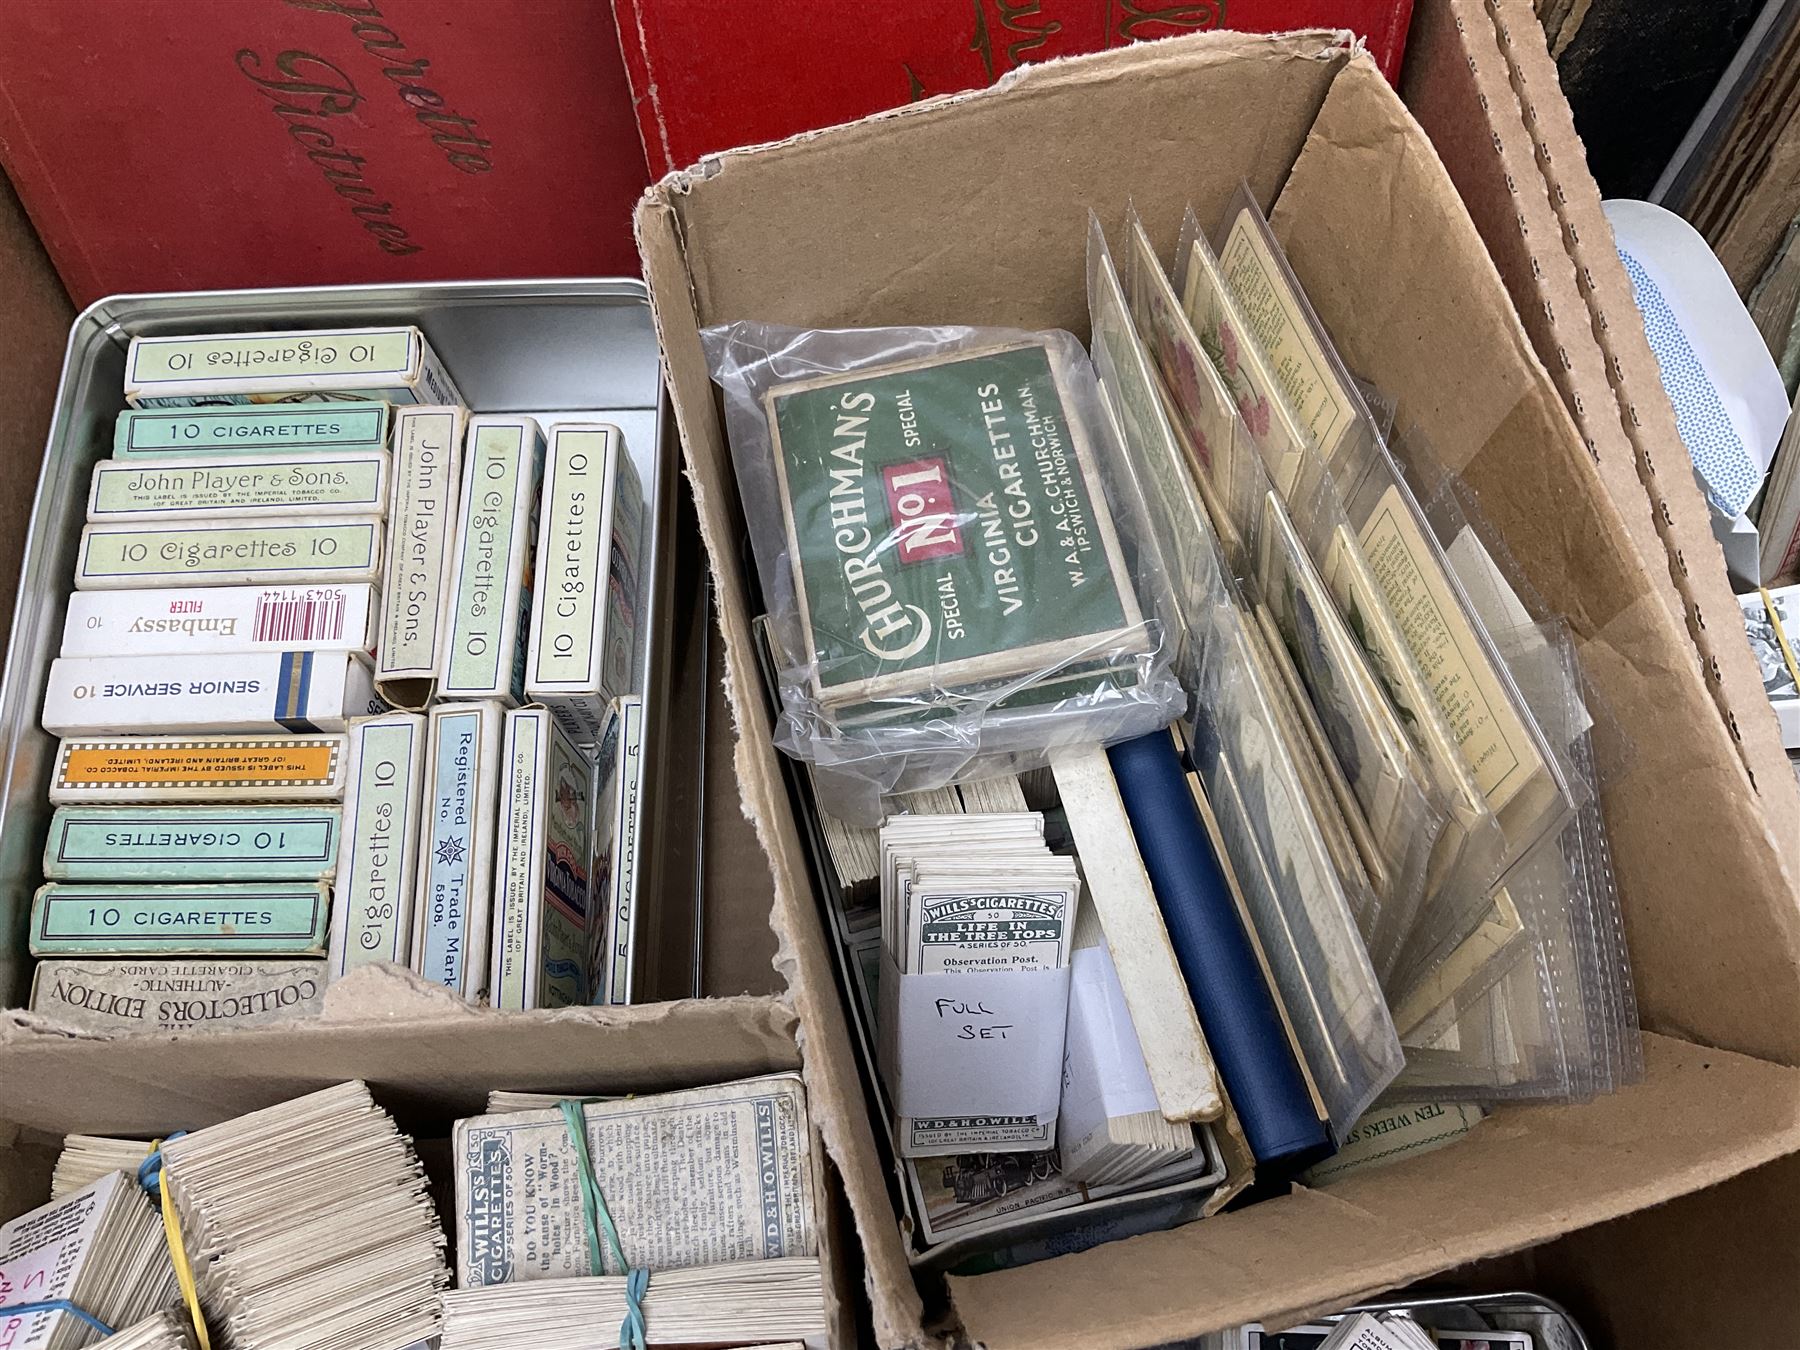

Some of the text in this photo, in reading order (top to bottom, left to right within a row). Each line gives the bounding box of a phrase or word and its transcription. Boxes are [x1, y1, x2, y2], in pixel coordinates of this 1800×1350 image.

[235, 49, 423, 256] Pictures
[167, 339, 374, 371] 10 Cigarettes 10
[896, 388, 921, 447] SPECIAL
[171, 423, 340, 438] 10 CIGARETTES
[414, 439, 440, 491] John
[978, 383, 1039, 547] CIGARETTES
[127, 464, 348, 494] John Player & Sons.
[1043, 415, 1092, 552] IPSWICH & NORWICH
[406, 497, 435, 566] Player
[830, 391, 932, 661] CHURCHMAN'S
[120, 536, 337, 569] 10 Cigarettes 10
[461, 455, 506, 657] 10 Cigarettes 10
[553, 452, 593, 658] 10 Cigarettes 10
[976, 491, 1024, 617] VIRGINIA
[408, 571, 427, 585] &
[168, 599, 202, 614] FILTER
[936, 572, 965, 640] SPECIAL
[86, 616, 237, 635] Embassy 10
[72, 679, 260, 698] SENIOR SERVICE 10
[373, 759, 396, 789] 10
[105, 831, 285, 849] 10 CIGARETTES
[442, 731, 473, 987] Registered Trade Mark
[511, 865, 517, 876] BY
[359, 801, 402, 951] Cigarettes
[89, 907, 272, 926] 10 CIGARETTES
[509, 914, 514, 923] IS
[976, 897, 1057, 915] CIGARETTES
[927, 929, 1055, 942] THE TREE TOPS
[956, 920, 1027, 932] LIFE IN
[967, 941, 998, 949] SERIES
[119, 964, 252, 976] CIGARETTE CARDS
[943, 955, 1039, 966] Observation Post.
[945, 966, 961, 974] This
[1021, 964, 1038, 972] Post
[51, 978, 317, 1022] COLLECTORS EDITION
[935, 998, 995, 1018] FULL
[957, 1025, 1014, 1040] SET
[1414, 1103, 1445, 1122] TEN
[729, 1110, 740, 1168] Westminster
[1363, 1114, 1412, 1139] WEEKS
[505, 1167, 514, 1243] SERIES OF 50
[525, 1153, 537, 1261] DO YOU KNOW
[539, 1196, 549, 1208] of
[995, 1201, 1020, 1214] UNION
[490, 1150, 503, 1281] CIGARETTES
[540, 1213, 550, 1246] cause
[541, 1251, 551, 1270] the
[563, 1249, 571, 1268] Our
